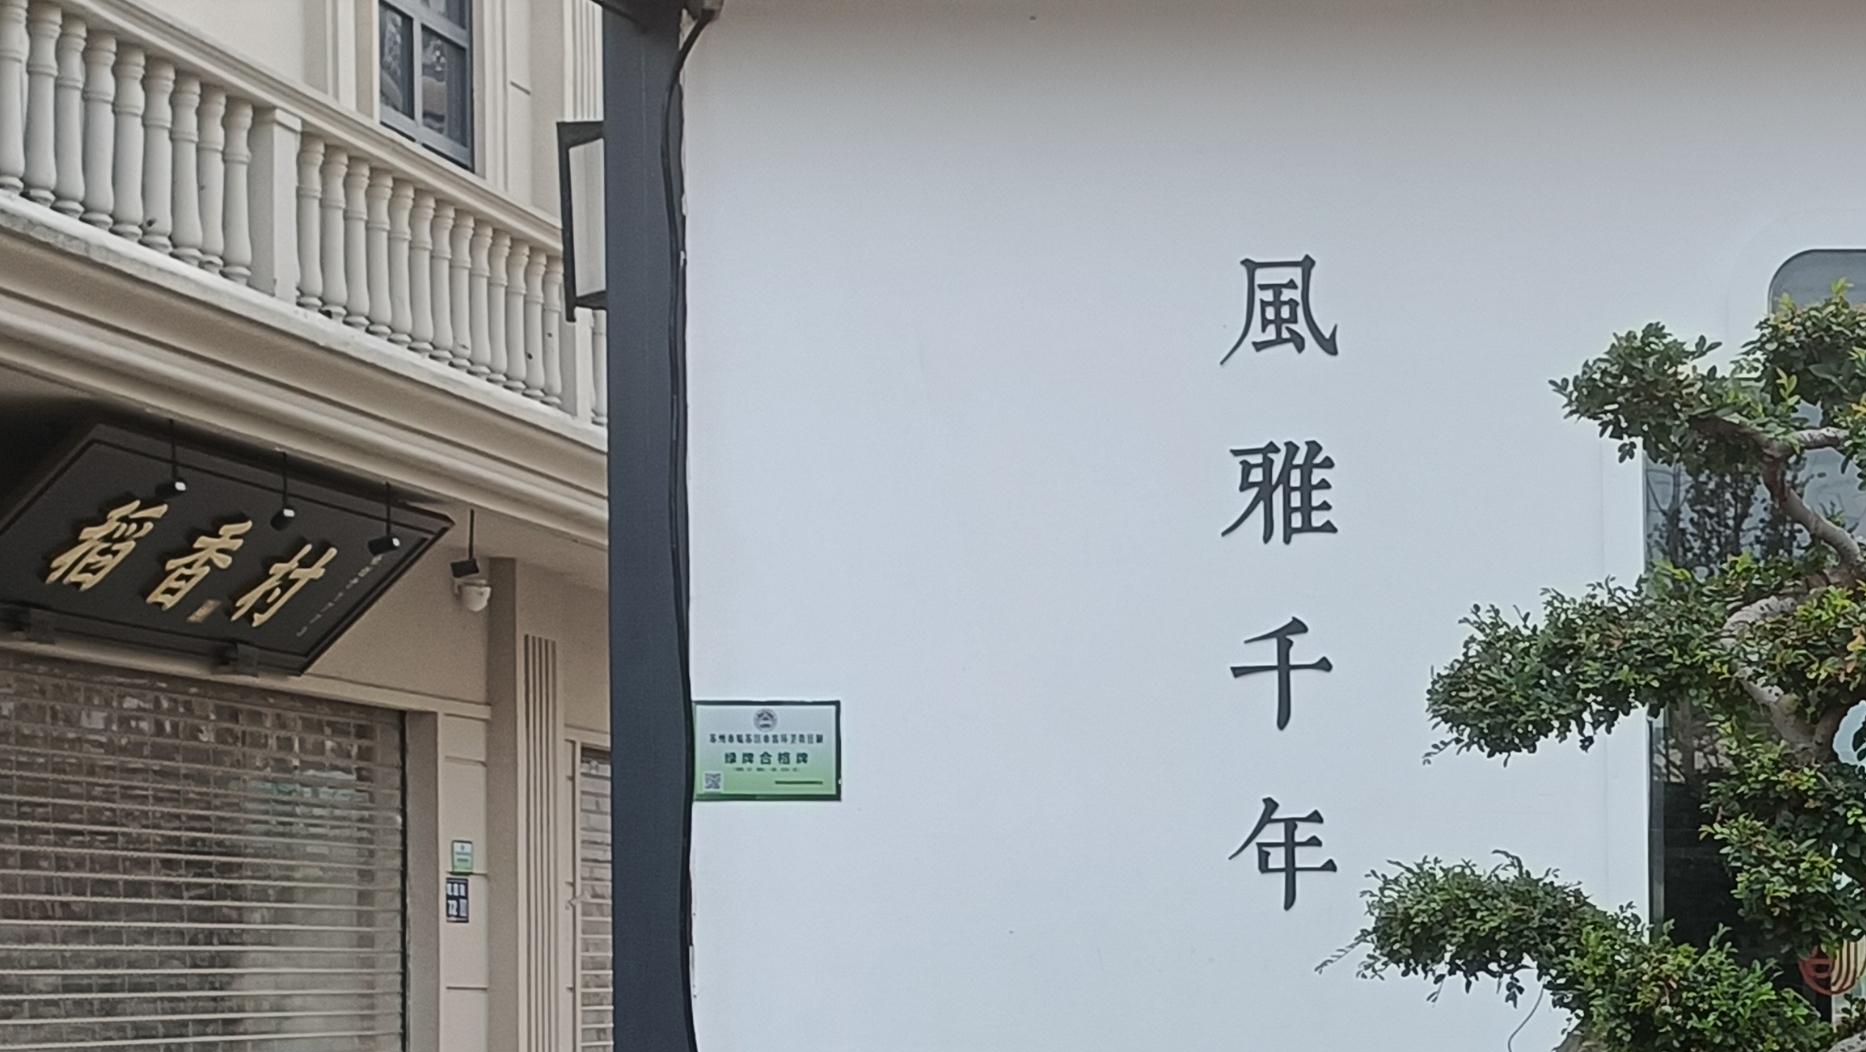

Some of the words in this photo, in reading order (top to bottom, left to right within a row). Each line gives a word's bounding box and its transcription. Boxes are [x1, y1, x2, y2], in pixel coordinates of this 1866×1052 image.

[45, 498, 338, 628] 稻香村
[1220, 253, 1338, 912] 風雅千年
